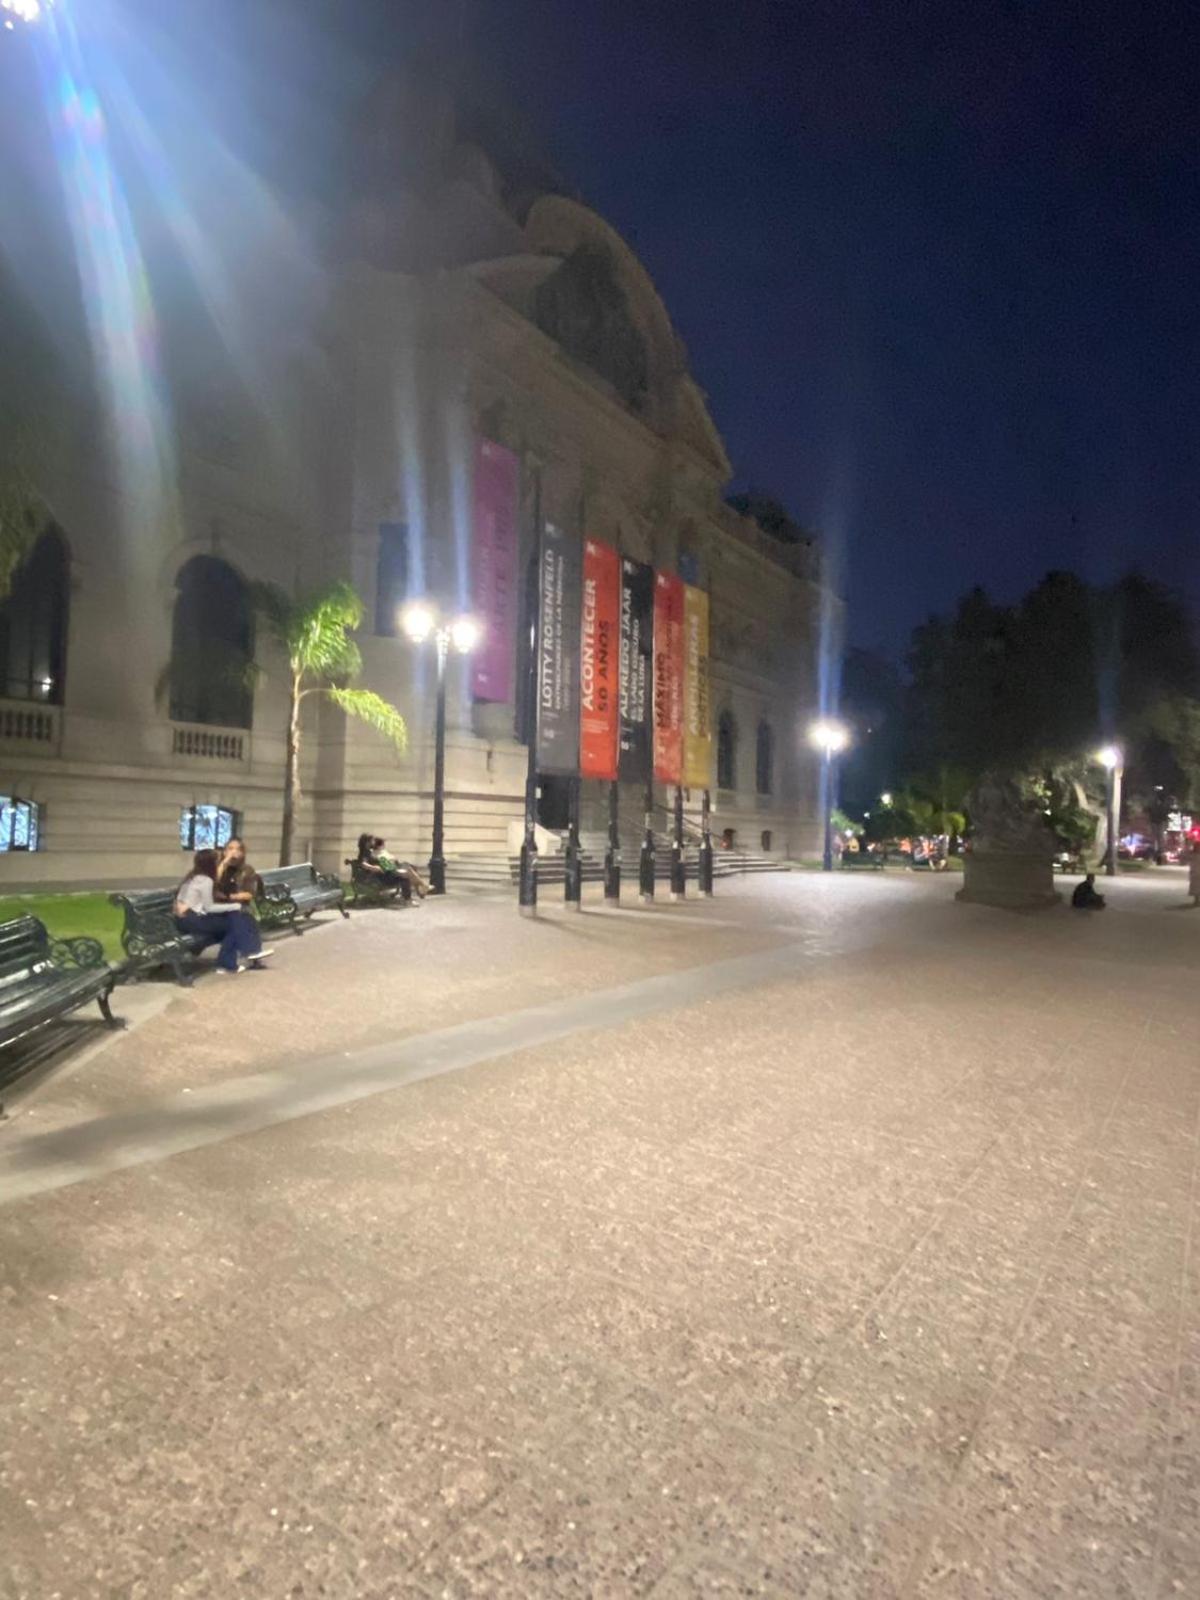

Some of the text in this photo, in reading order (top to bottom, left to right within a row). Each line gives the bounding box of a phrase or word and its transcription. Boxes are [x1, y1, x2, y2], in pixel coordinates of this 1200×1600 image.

[541, 549, 554, 708] LOTTY ROSENFELD
[556, 607, 563, 621] LA
[582, 578, 596, 711] ACONTECER
[619, 587, 632, 719] ALFREDO JAAR
[630, 619, 640, 721] EL LADO OSCURO
[597, 687, 608, 712] 50
[637, 709, 644, 722] DE
[638, 689, 644, 704] LA
